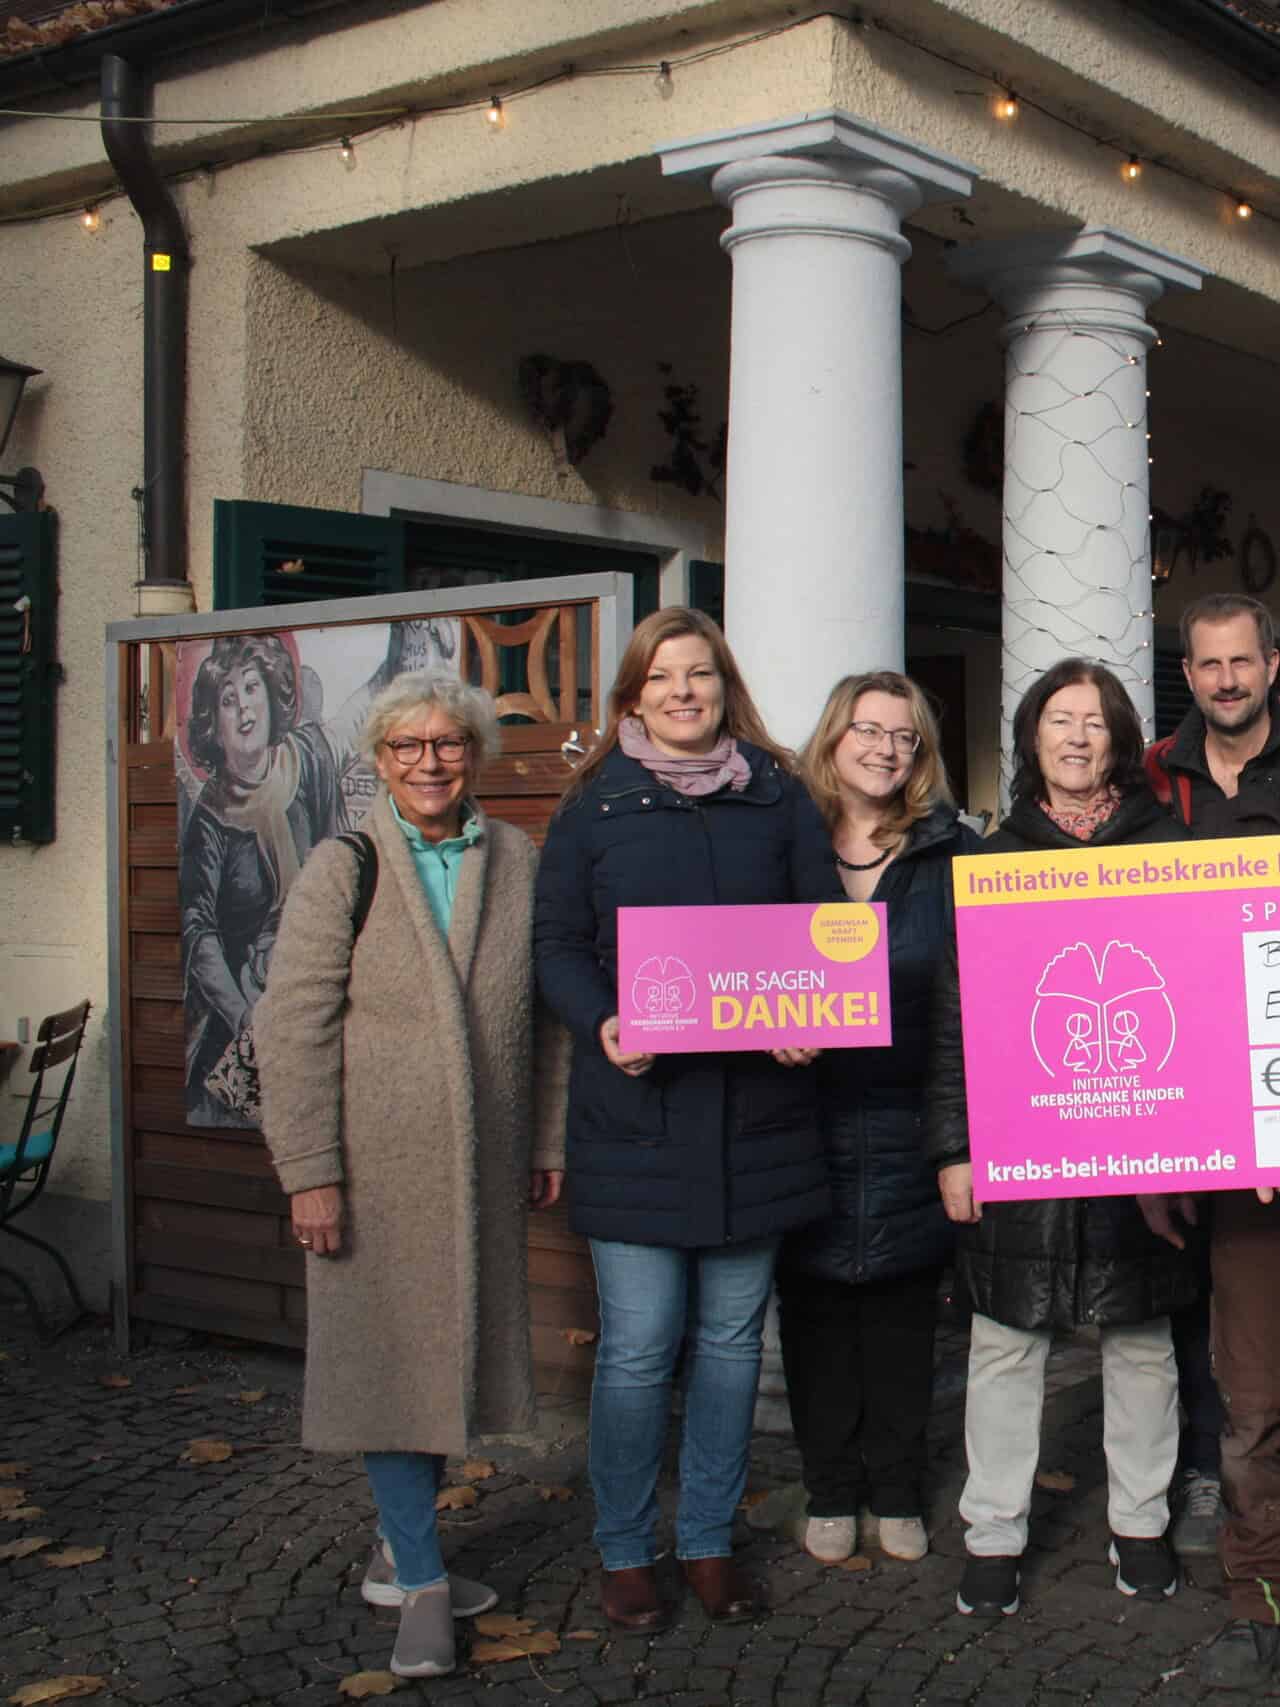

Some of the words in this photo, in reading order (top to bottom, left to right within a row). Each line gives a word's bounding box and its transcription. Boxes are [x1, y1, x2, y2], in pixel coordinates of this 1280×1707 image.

[967, 866, 1090, 896] Initiative
[1096, 854, 1269, 887] krebskranke
[708, 972, 748, 992] WIR
[755, 969, 825, 990] SAGEN
[711, 991, 880, 1031] DANKE!
[1072, 1075, 1141, 1091] INITIATIVE
[1031, 1090, 1129, 1107] KREBSKRANKE
[1133, 1087, 1185, 1102] KINDER
[1059, 1104, 1131, 1121] MÜNCHEN
[1135, 1103, 1158, 1117] E.V.
[987, 1150, 1237, 1184] krebs-bei-kindern.de
